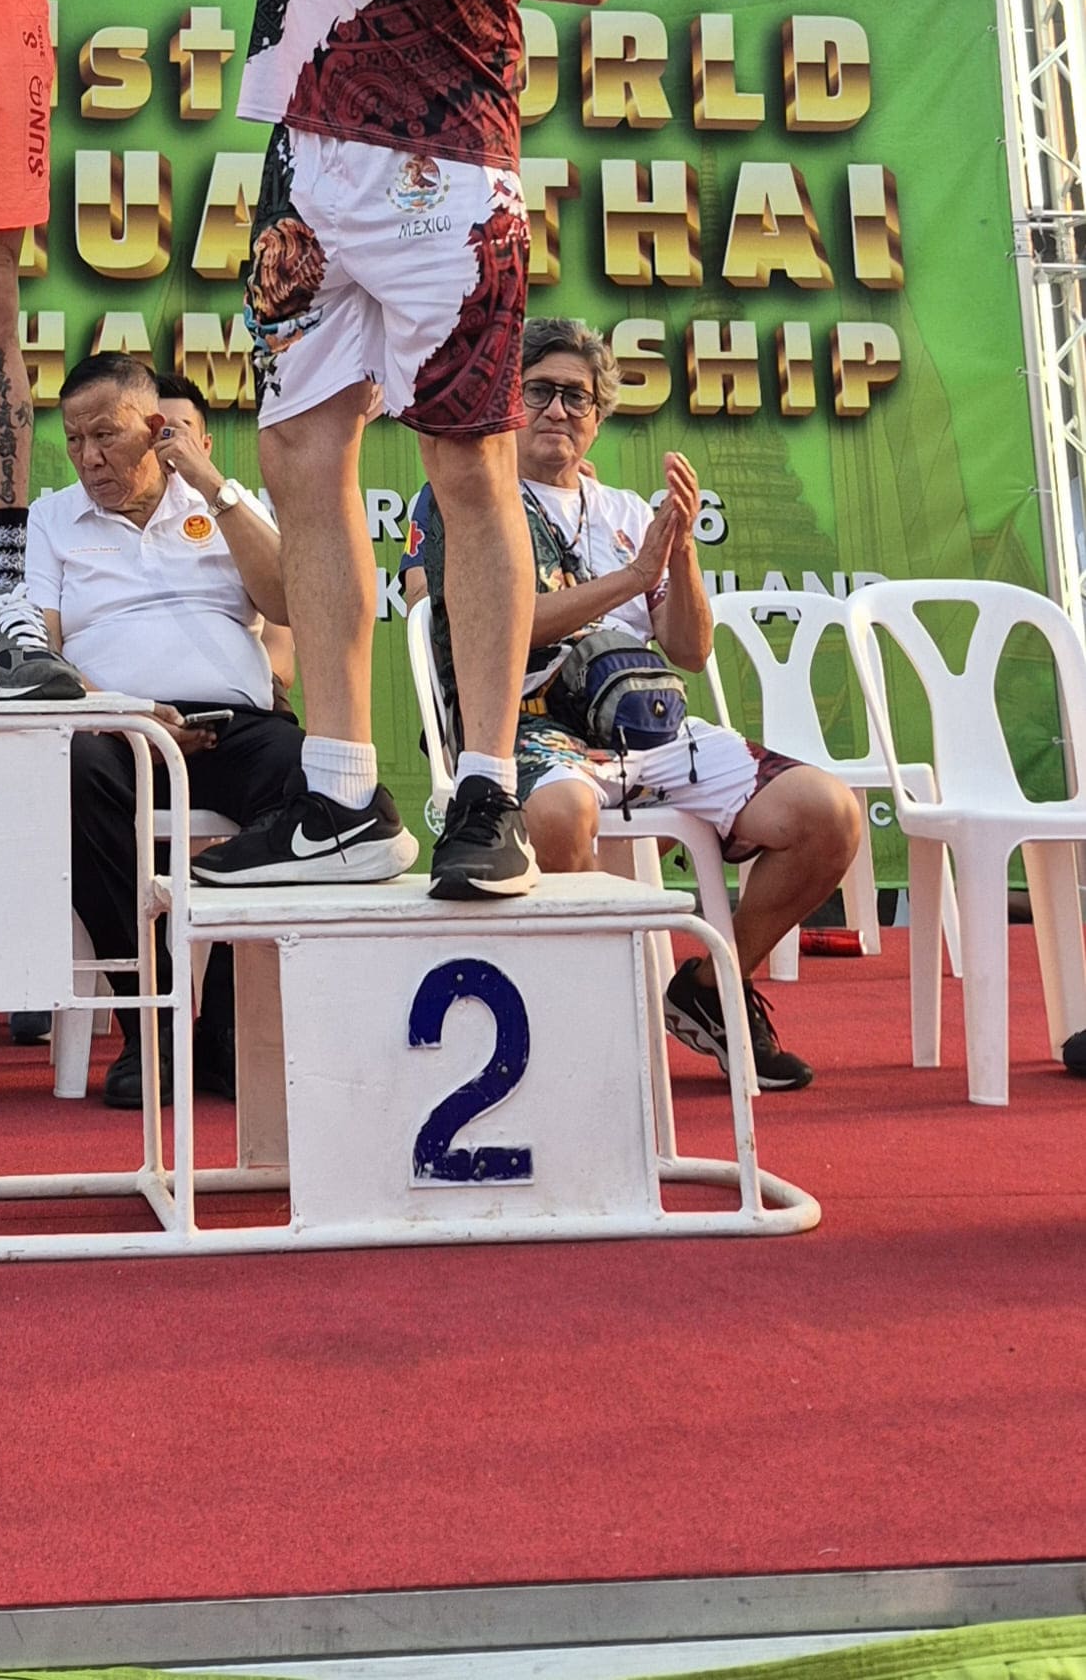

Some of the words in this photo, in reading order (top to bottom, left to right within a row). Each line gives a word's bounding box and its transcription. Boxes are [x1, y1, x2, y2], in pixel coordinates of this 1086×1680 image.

[519, 8, 872, 132] ORLD
[397, 214, 452, 239] MEXICO
[407, 957, 536, 1188] 2
